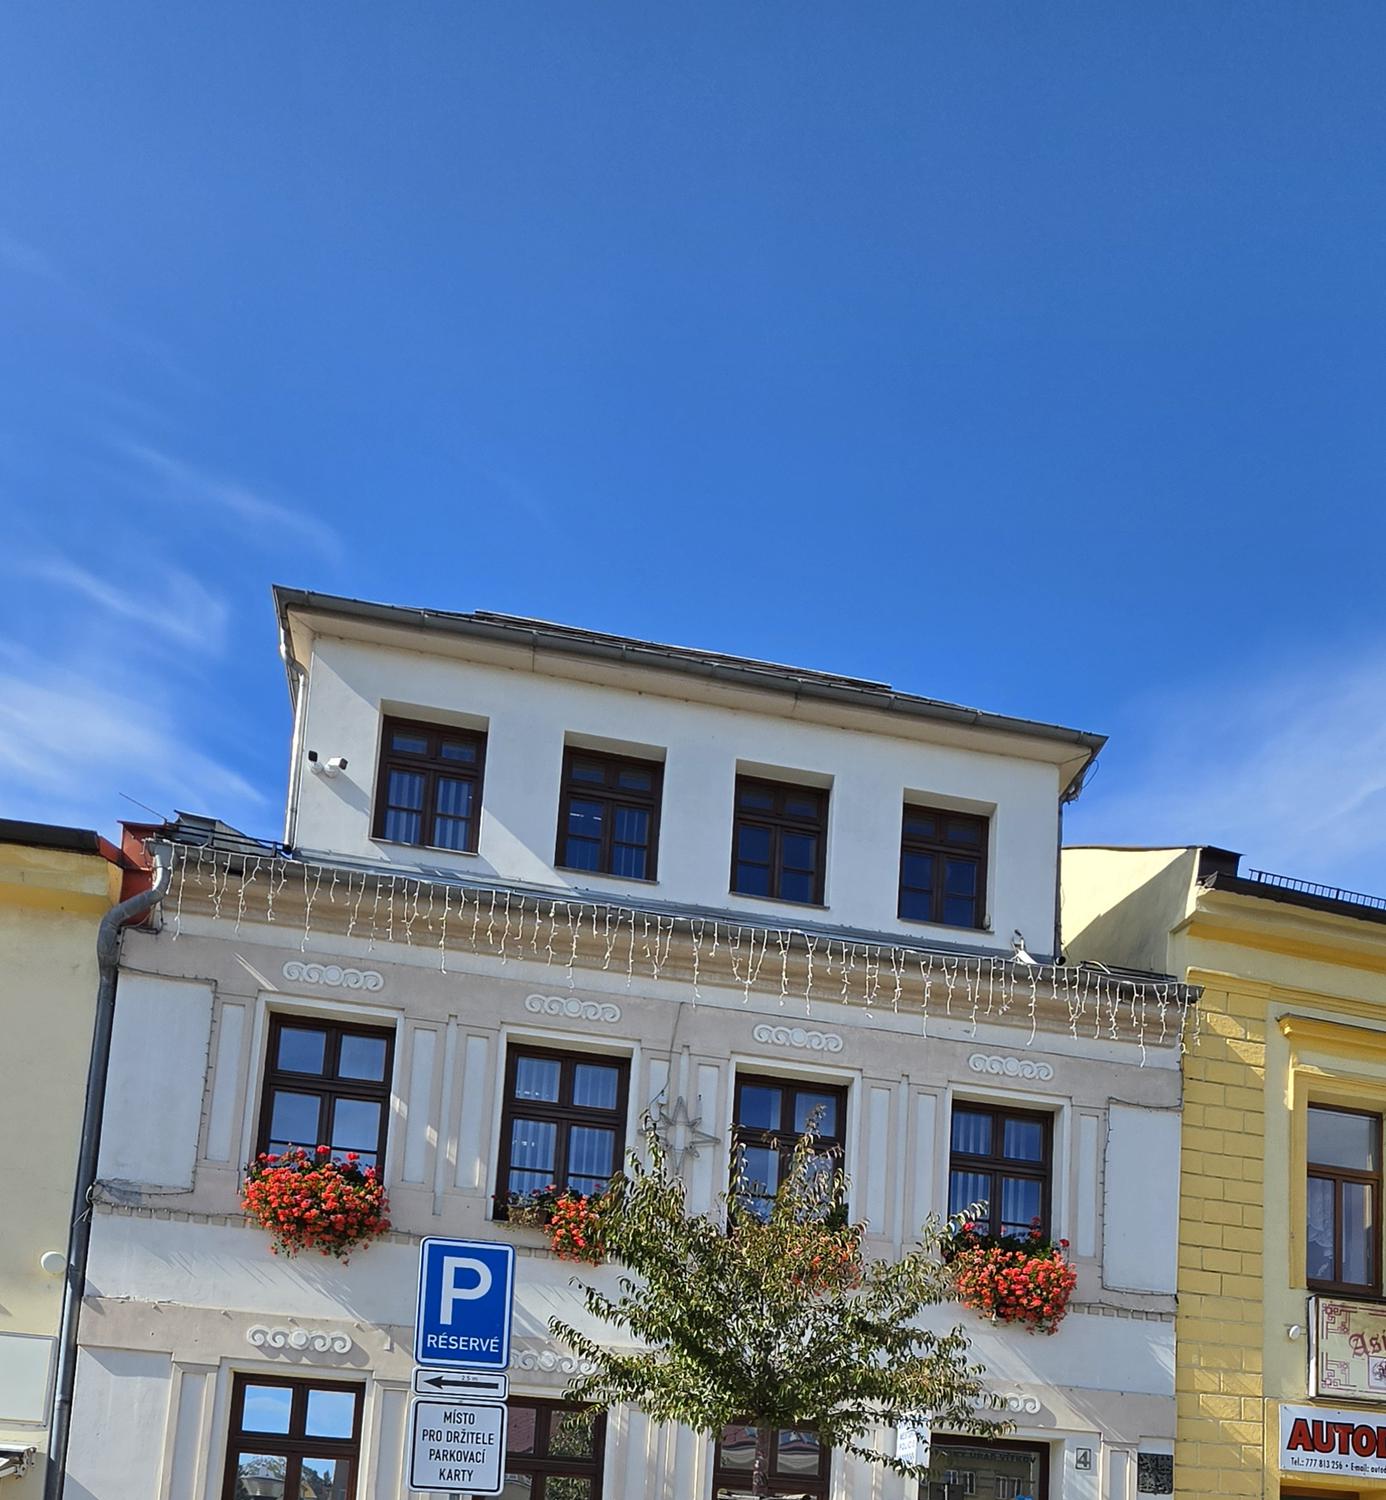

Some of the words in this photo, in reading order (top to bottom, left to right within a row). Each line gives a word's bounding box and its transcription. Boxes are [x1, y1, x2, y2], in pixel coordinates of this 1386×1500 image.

[440, 1255, 492, 1325] P
[427, 1332, 500, 1353] RÉSERVÉ
[443, 1409, 475, 1426] MÍSTO
[422, 1429, 443, 1442] PRO
[446, 1427, 494, 1445] DRŽITELE
[428, 1447, 486, 1464] PARKOVACÍ
[1078, 1450, 1090, 1467] 4
[1305, 1458, 1318, 1468] 777
[1319, 1459, 1330, 1469] 813
[1331, 1460, 1343, 1470] 256
[439, 1468, 474, 1482] KARTY
